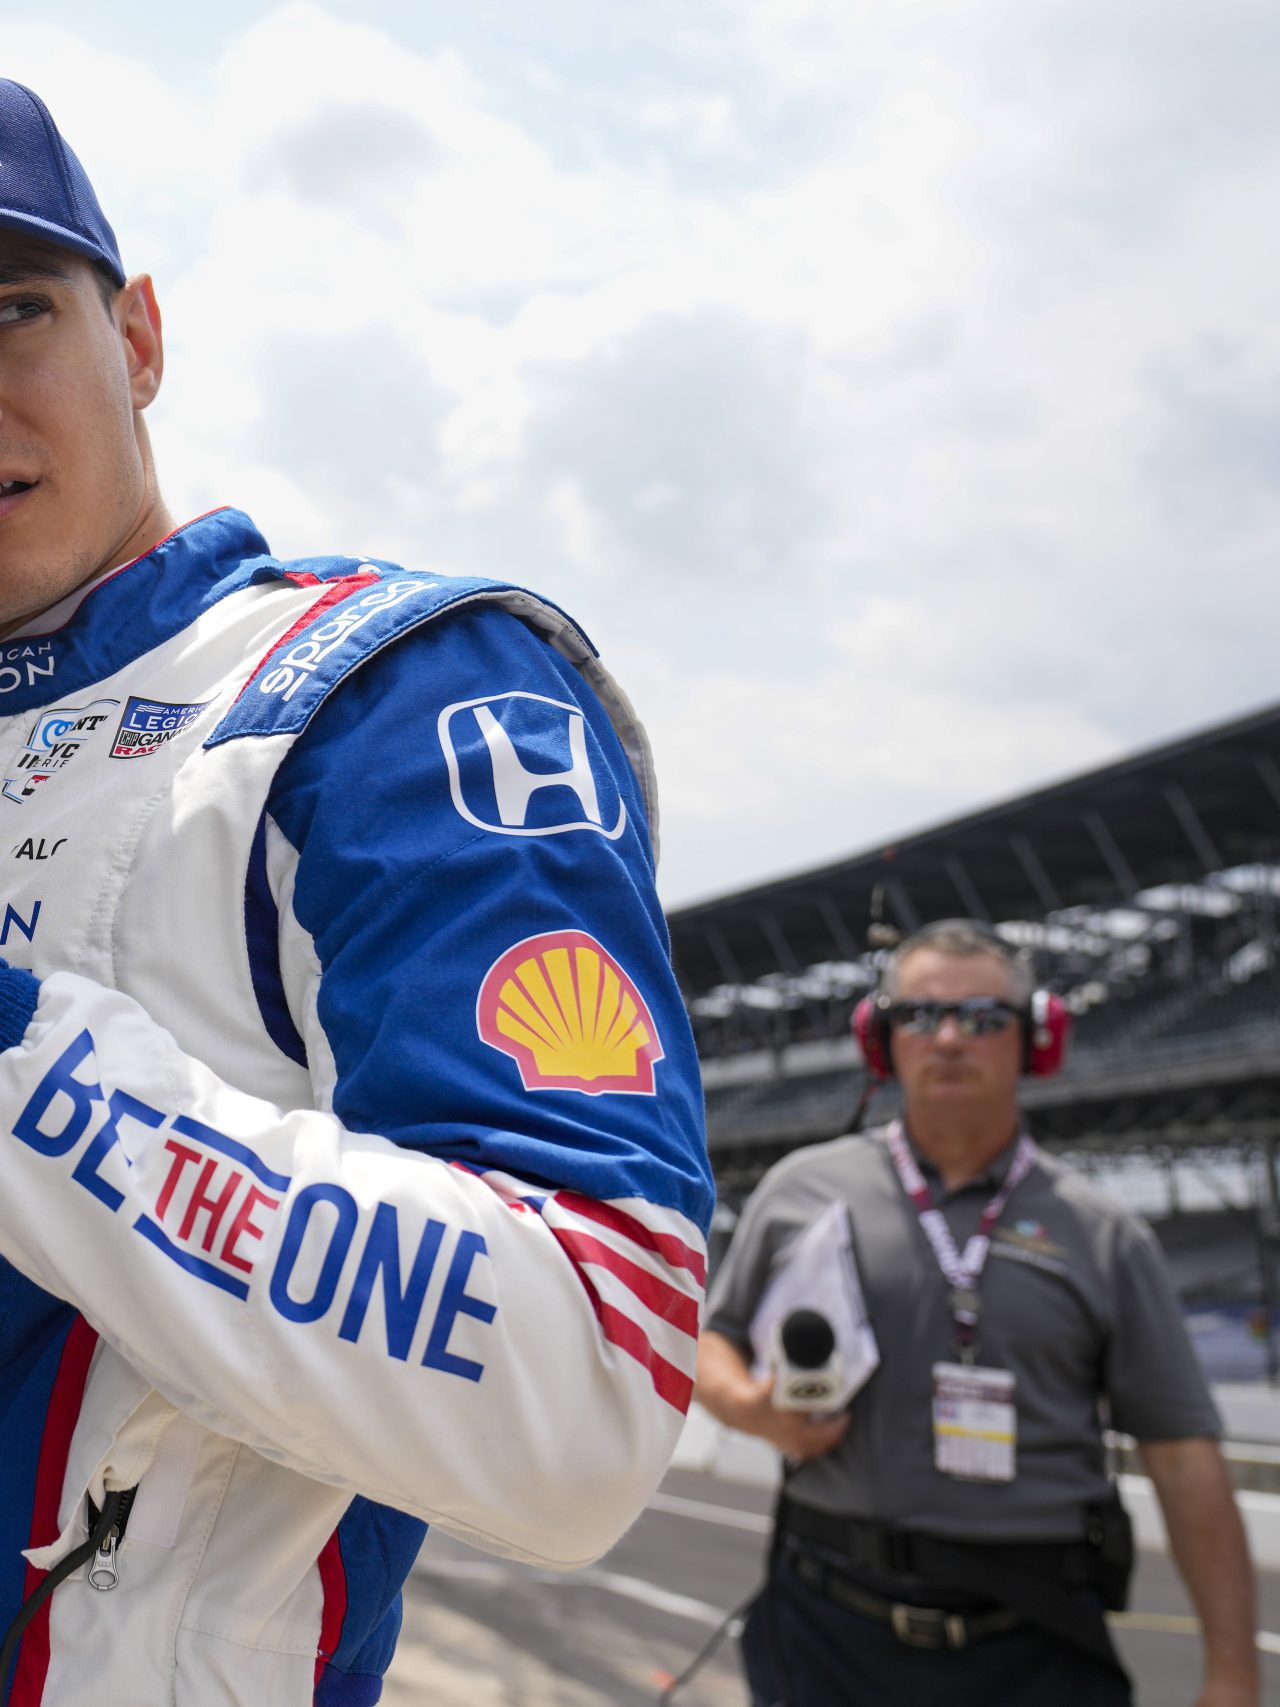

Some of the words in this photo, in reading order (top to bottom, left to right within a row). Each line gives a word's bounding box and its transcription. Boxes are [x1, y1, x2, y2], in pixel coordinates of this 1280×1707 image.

[11, 1028, 164, 1213] BE
[154, 1138, 279, 1274] THE
[269, 1183, 498, 1383] ONE
